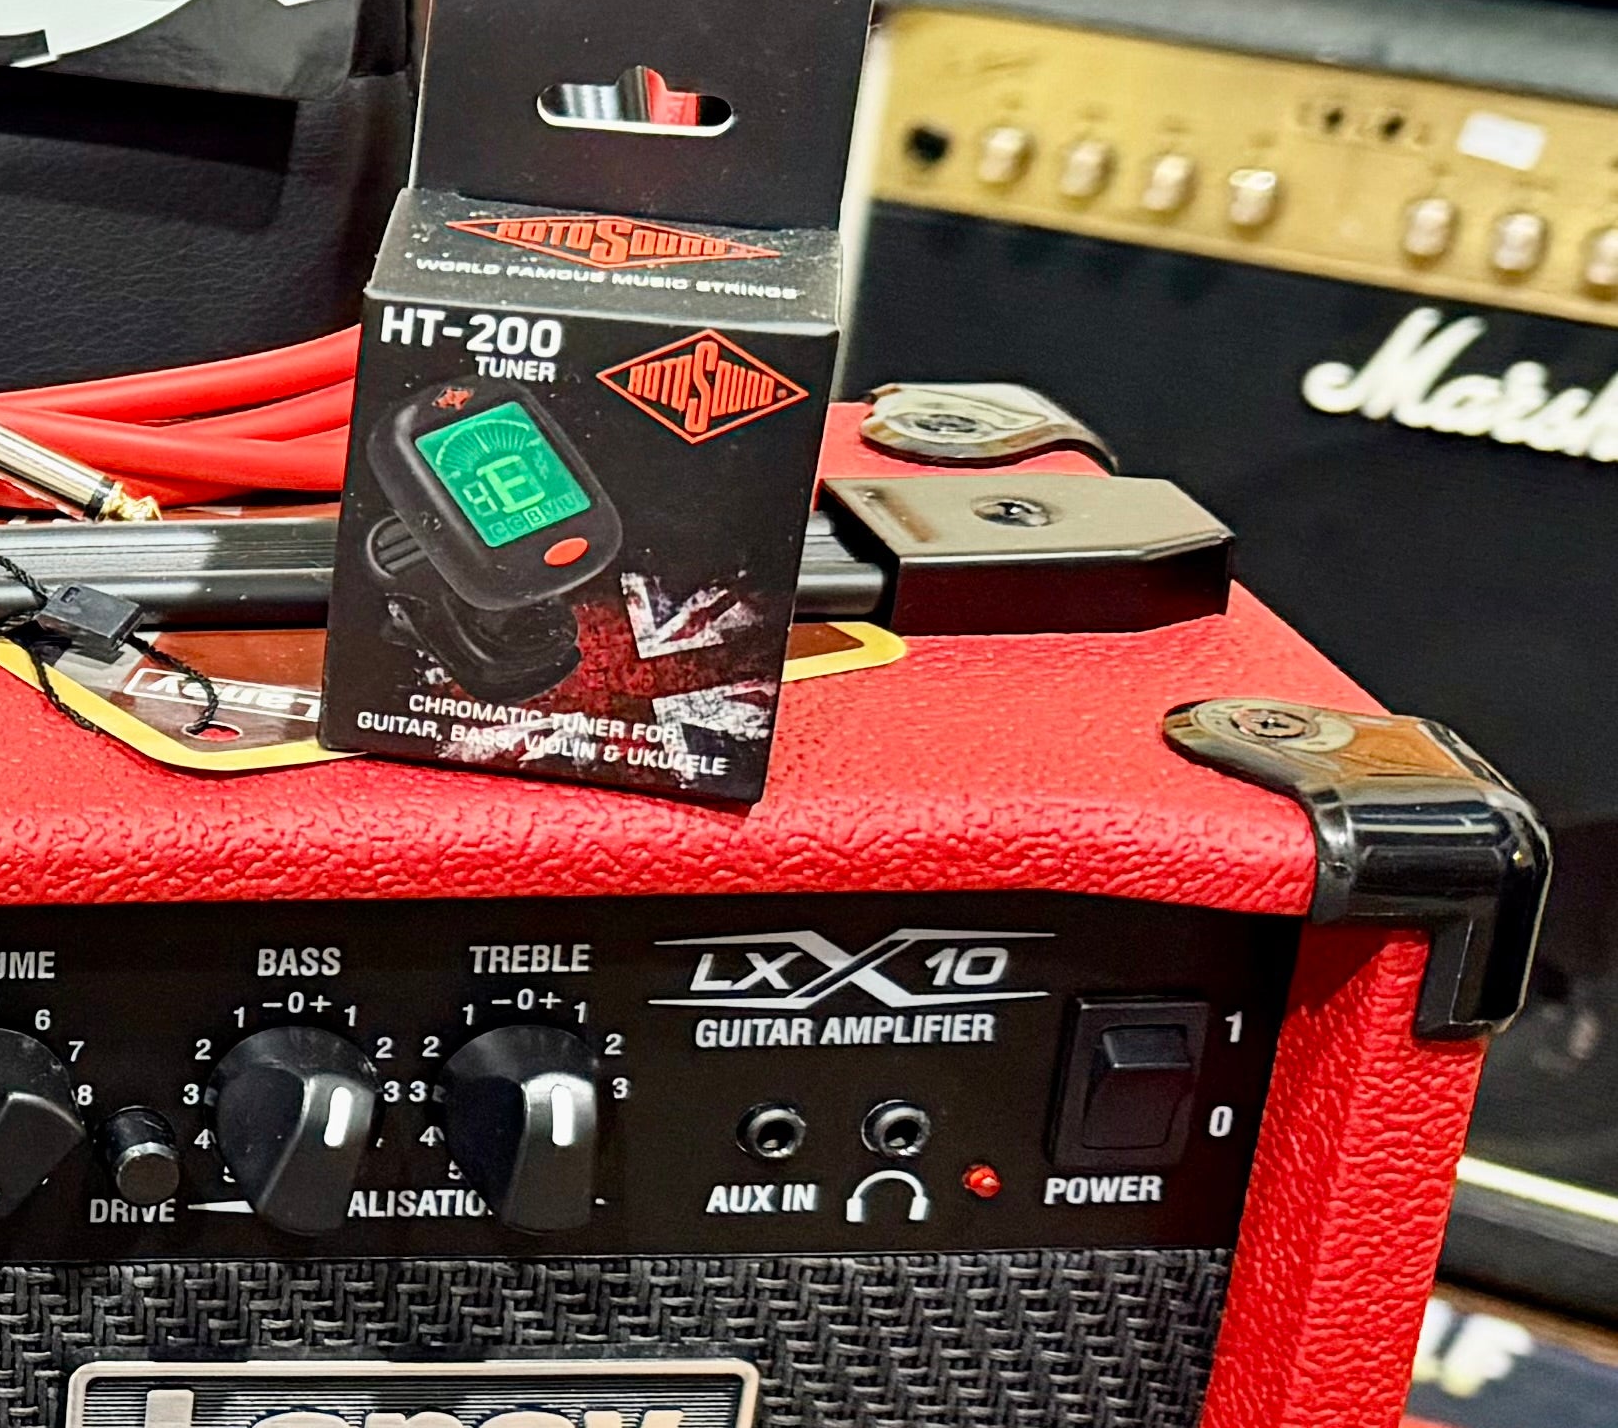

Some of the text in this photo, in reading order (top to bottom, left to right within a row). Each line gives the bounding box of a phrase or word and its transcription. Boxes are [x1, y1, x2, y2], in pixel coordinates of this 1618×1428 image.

[416, 258, 800, 300] WORLD FAMOUS MUSIC STRINGS
[380, 306, 563, 358] HT-200
[475, 355, 557, 383] TUNER
[476, 454, 545, 513] E
[409, 694, 679, 745] CHROMATIC TUNER FOR
[357, 711, 443, 742] GUITAR,
[450, 723, 516, 752] BASS,
[522, 733, 597, 760] VIOLIN
[627, 747, 729, 776] UKULELE
[257, 947, 342, 977] BASS
[469, 943, 592, 974] TREBLE
[34, 1009, 52, 1031] 6
[233, 1006, 246, 1028] 1
[345, 1004, 358, 1027] 1
[463, 1004, 475, 1026] 1
[574, 1002, 588, 1024] 1
[695, 1012, 996, 1048] GUITAR AMPLIFIER
[1225, 1010, 1244, 1043] 1
[68, 1041, 85, 1062] 7
[195, 1039, 212, 1061] 2
[376, 1037, 394, 1059] 2
[423, 1036, 440, 1058] 2
[604, 1034, 622, 1055] 2
[77, 1084, 93, 1106] 8
[182, 1084, 200, 1105] 3
[383, 1081, 400, 1103] 3
[409, 1081, 427, 1103] 3
[613, 1077, 630, 1099] 3
[1209, 1105, 1234, 1137] 0
[193, 1129, 211, 1149] 4
[419, 1126, 438, 1147] 4
[706, 1183, 818, 1214] AUX IN
[1044, 1174, 1162, 1206] POWER
[89, 1198, 176, 1225] DRIVE
[347, 1190, 495, 1218] ALISATIO
